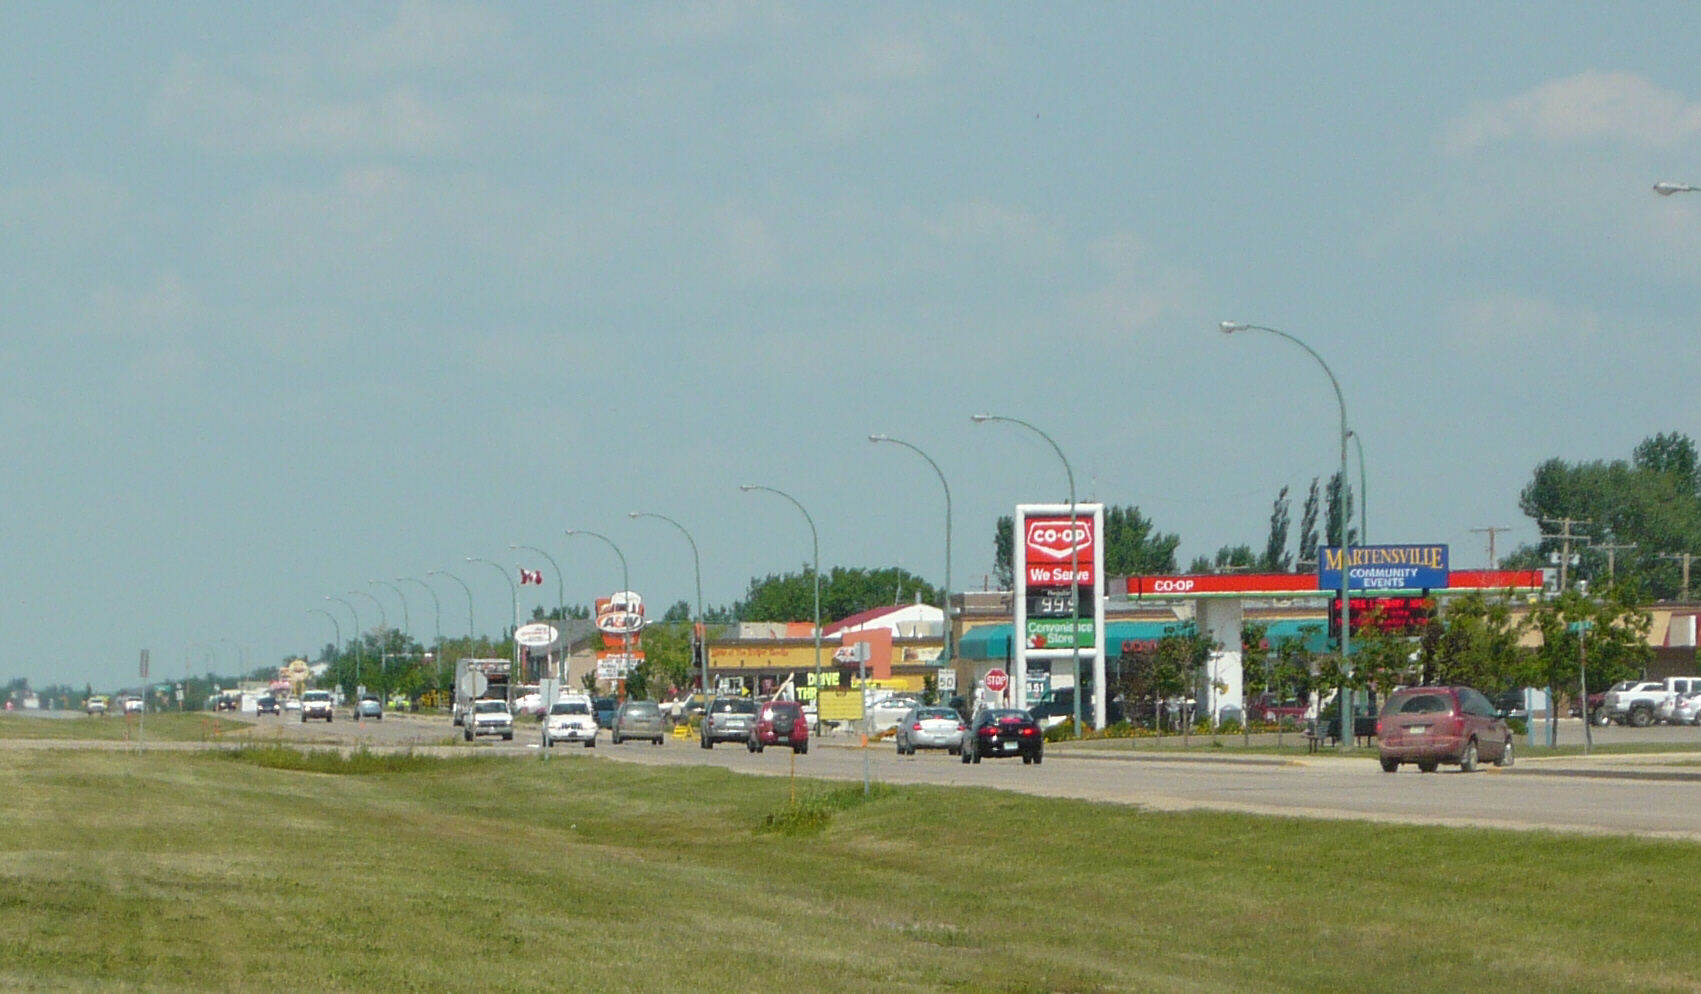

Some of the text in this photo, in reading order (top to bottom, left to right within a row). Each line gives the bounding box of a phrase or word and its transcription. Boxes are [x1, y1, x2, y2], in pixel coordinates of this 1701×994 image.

[1325, 546, 1444, 570] MARTENSVILLE
[1030, 568, 1090, 581] We Serve
[1349, 567, 1418, 578] COMMUNITY
[1154, 580, 1195, 592] CO-OP
[1363, 577, 1405, 588] EVENTS
[602, 616, 639, 627] A&W
[1047, 633, 1075, 643] Store
[939, 677, 954, 688] 50
[986, 675, 1006, 686] STOP
